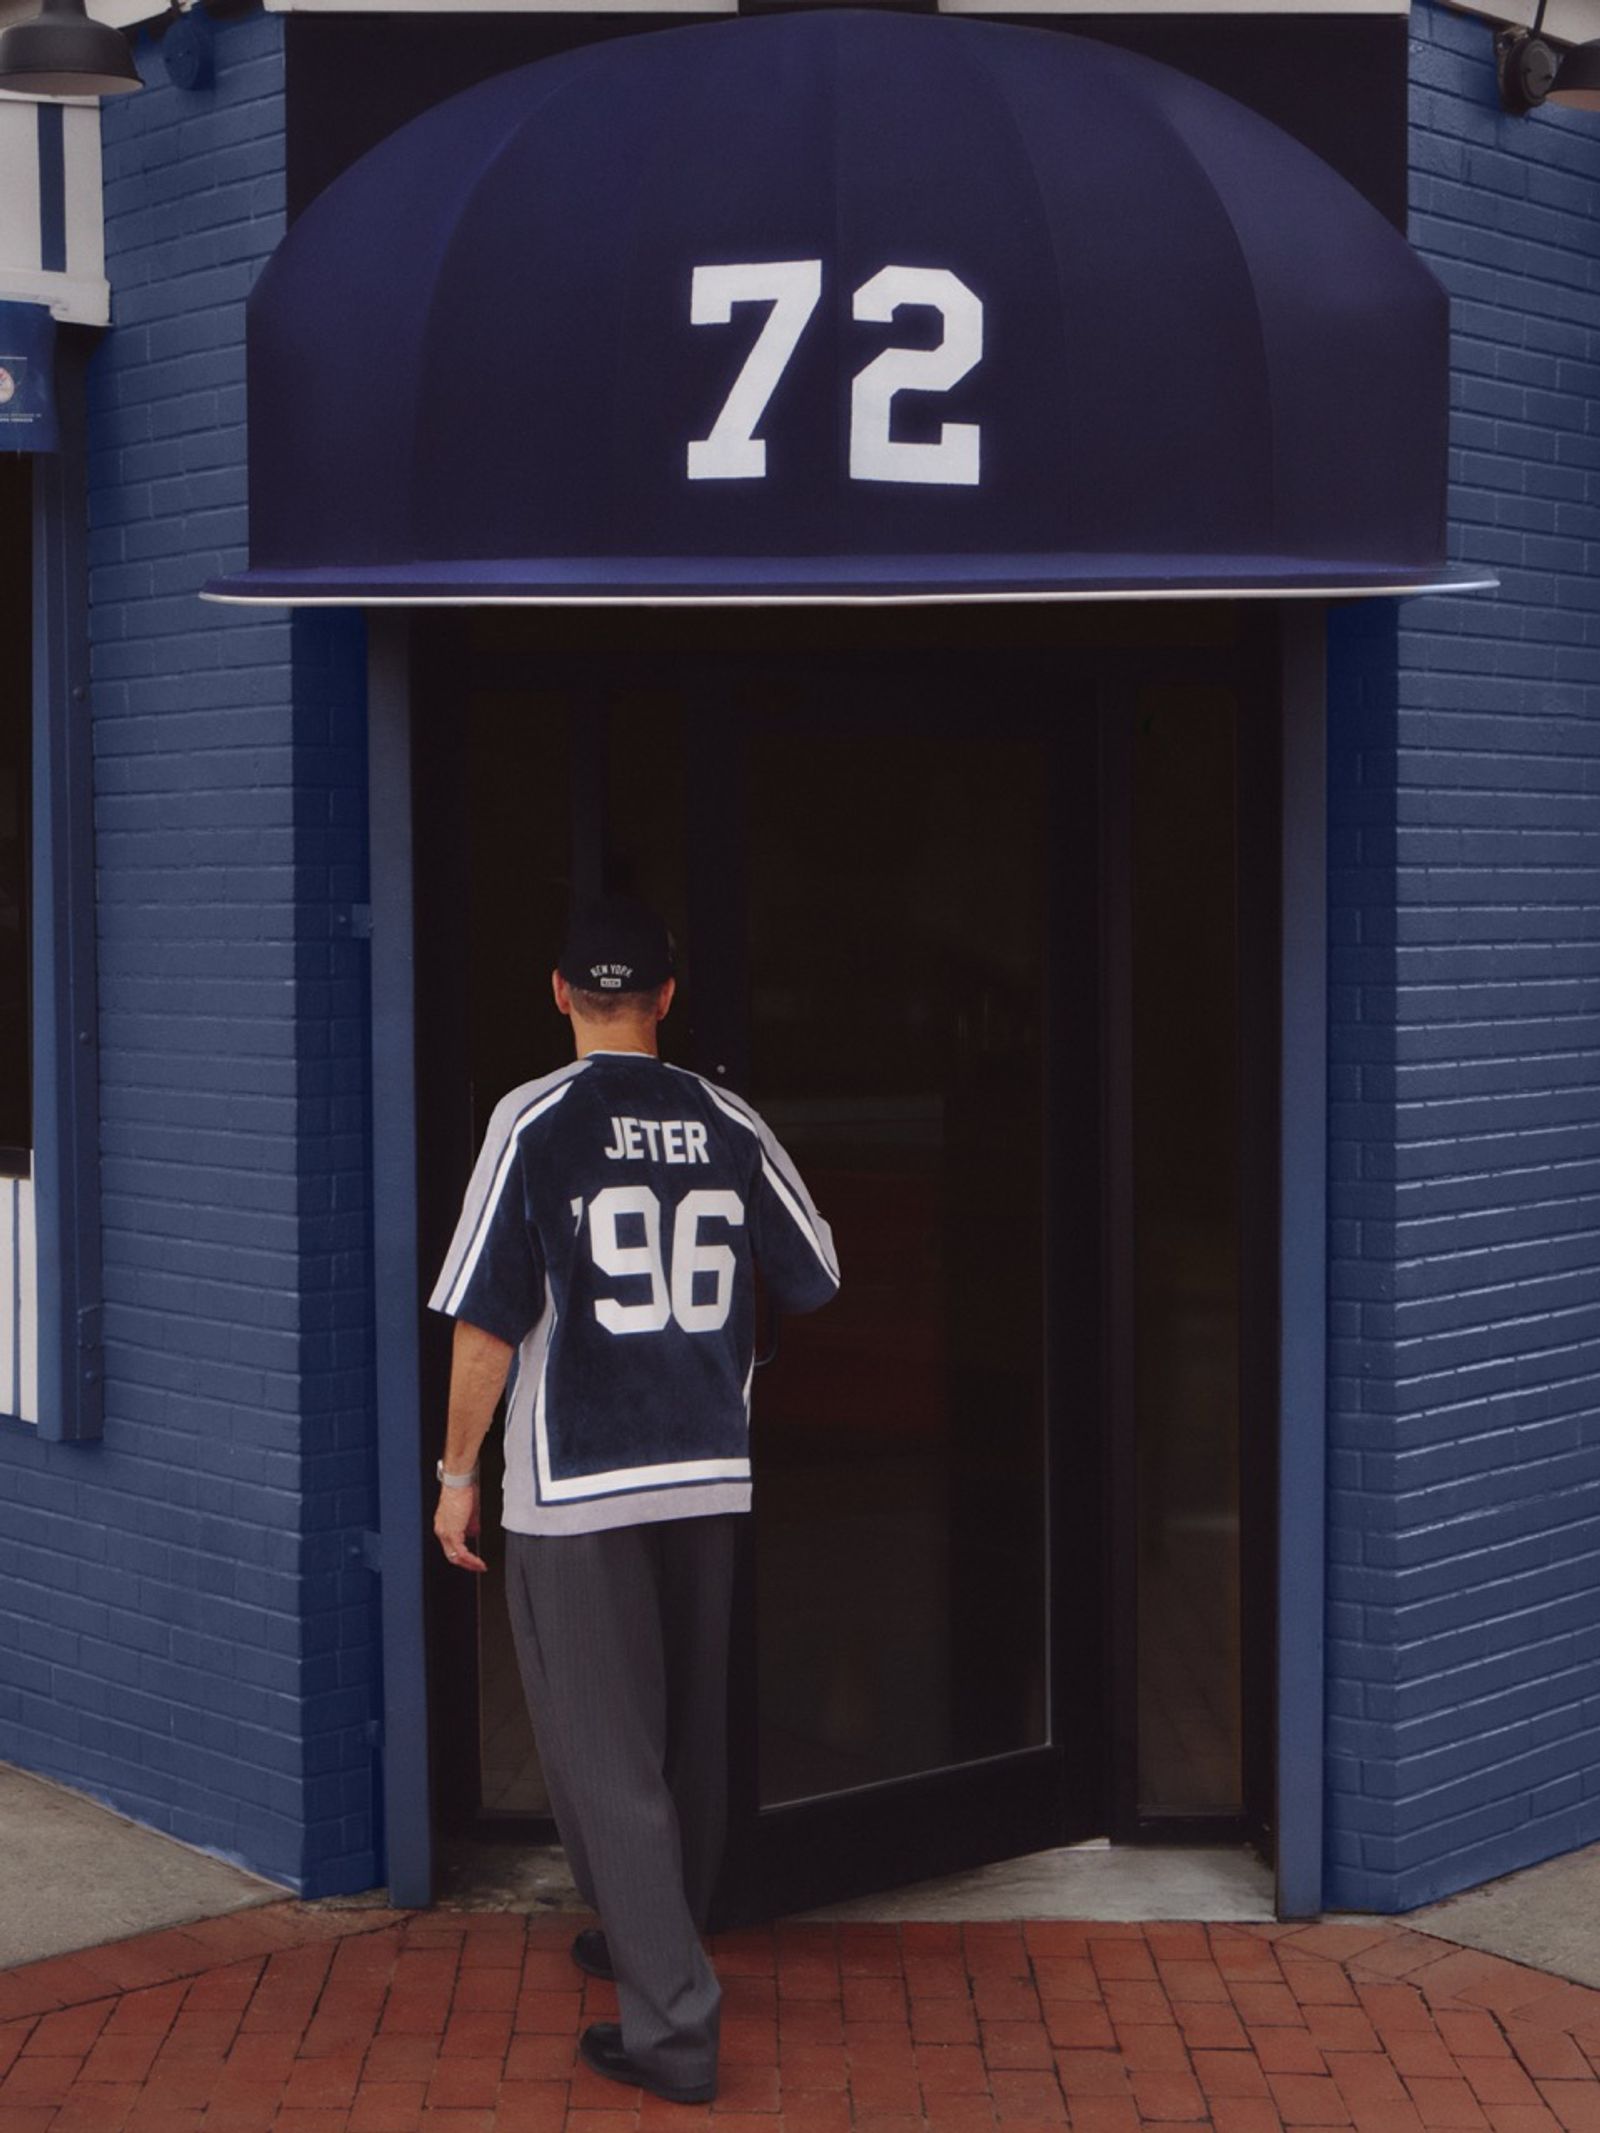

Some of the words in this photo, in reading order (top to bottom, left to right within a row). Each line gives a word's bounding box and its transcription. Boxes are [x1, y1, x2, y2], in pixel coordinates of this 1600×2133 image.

[687, 260, 983, 485] 72
[590, 964, 608, 978] NEW
[610, 964, 633, 978] YORK
[605, 1116, 710, 1164] JETER
